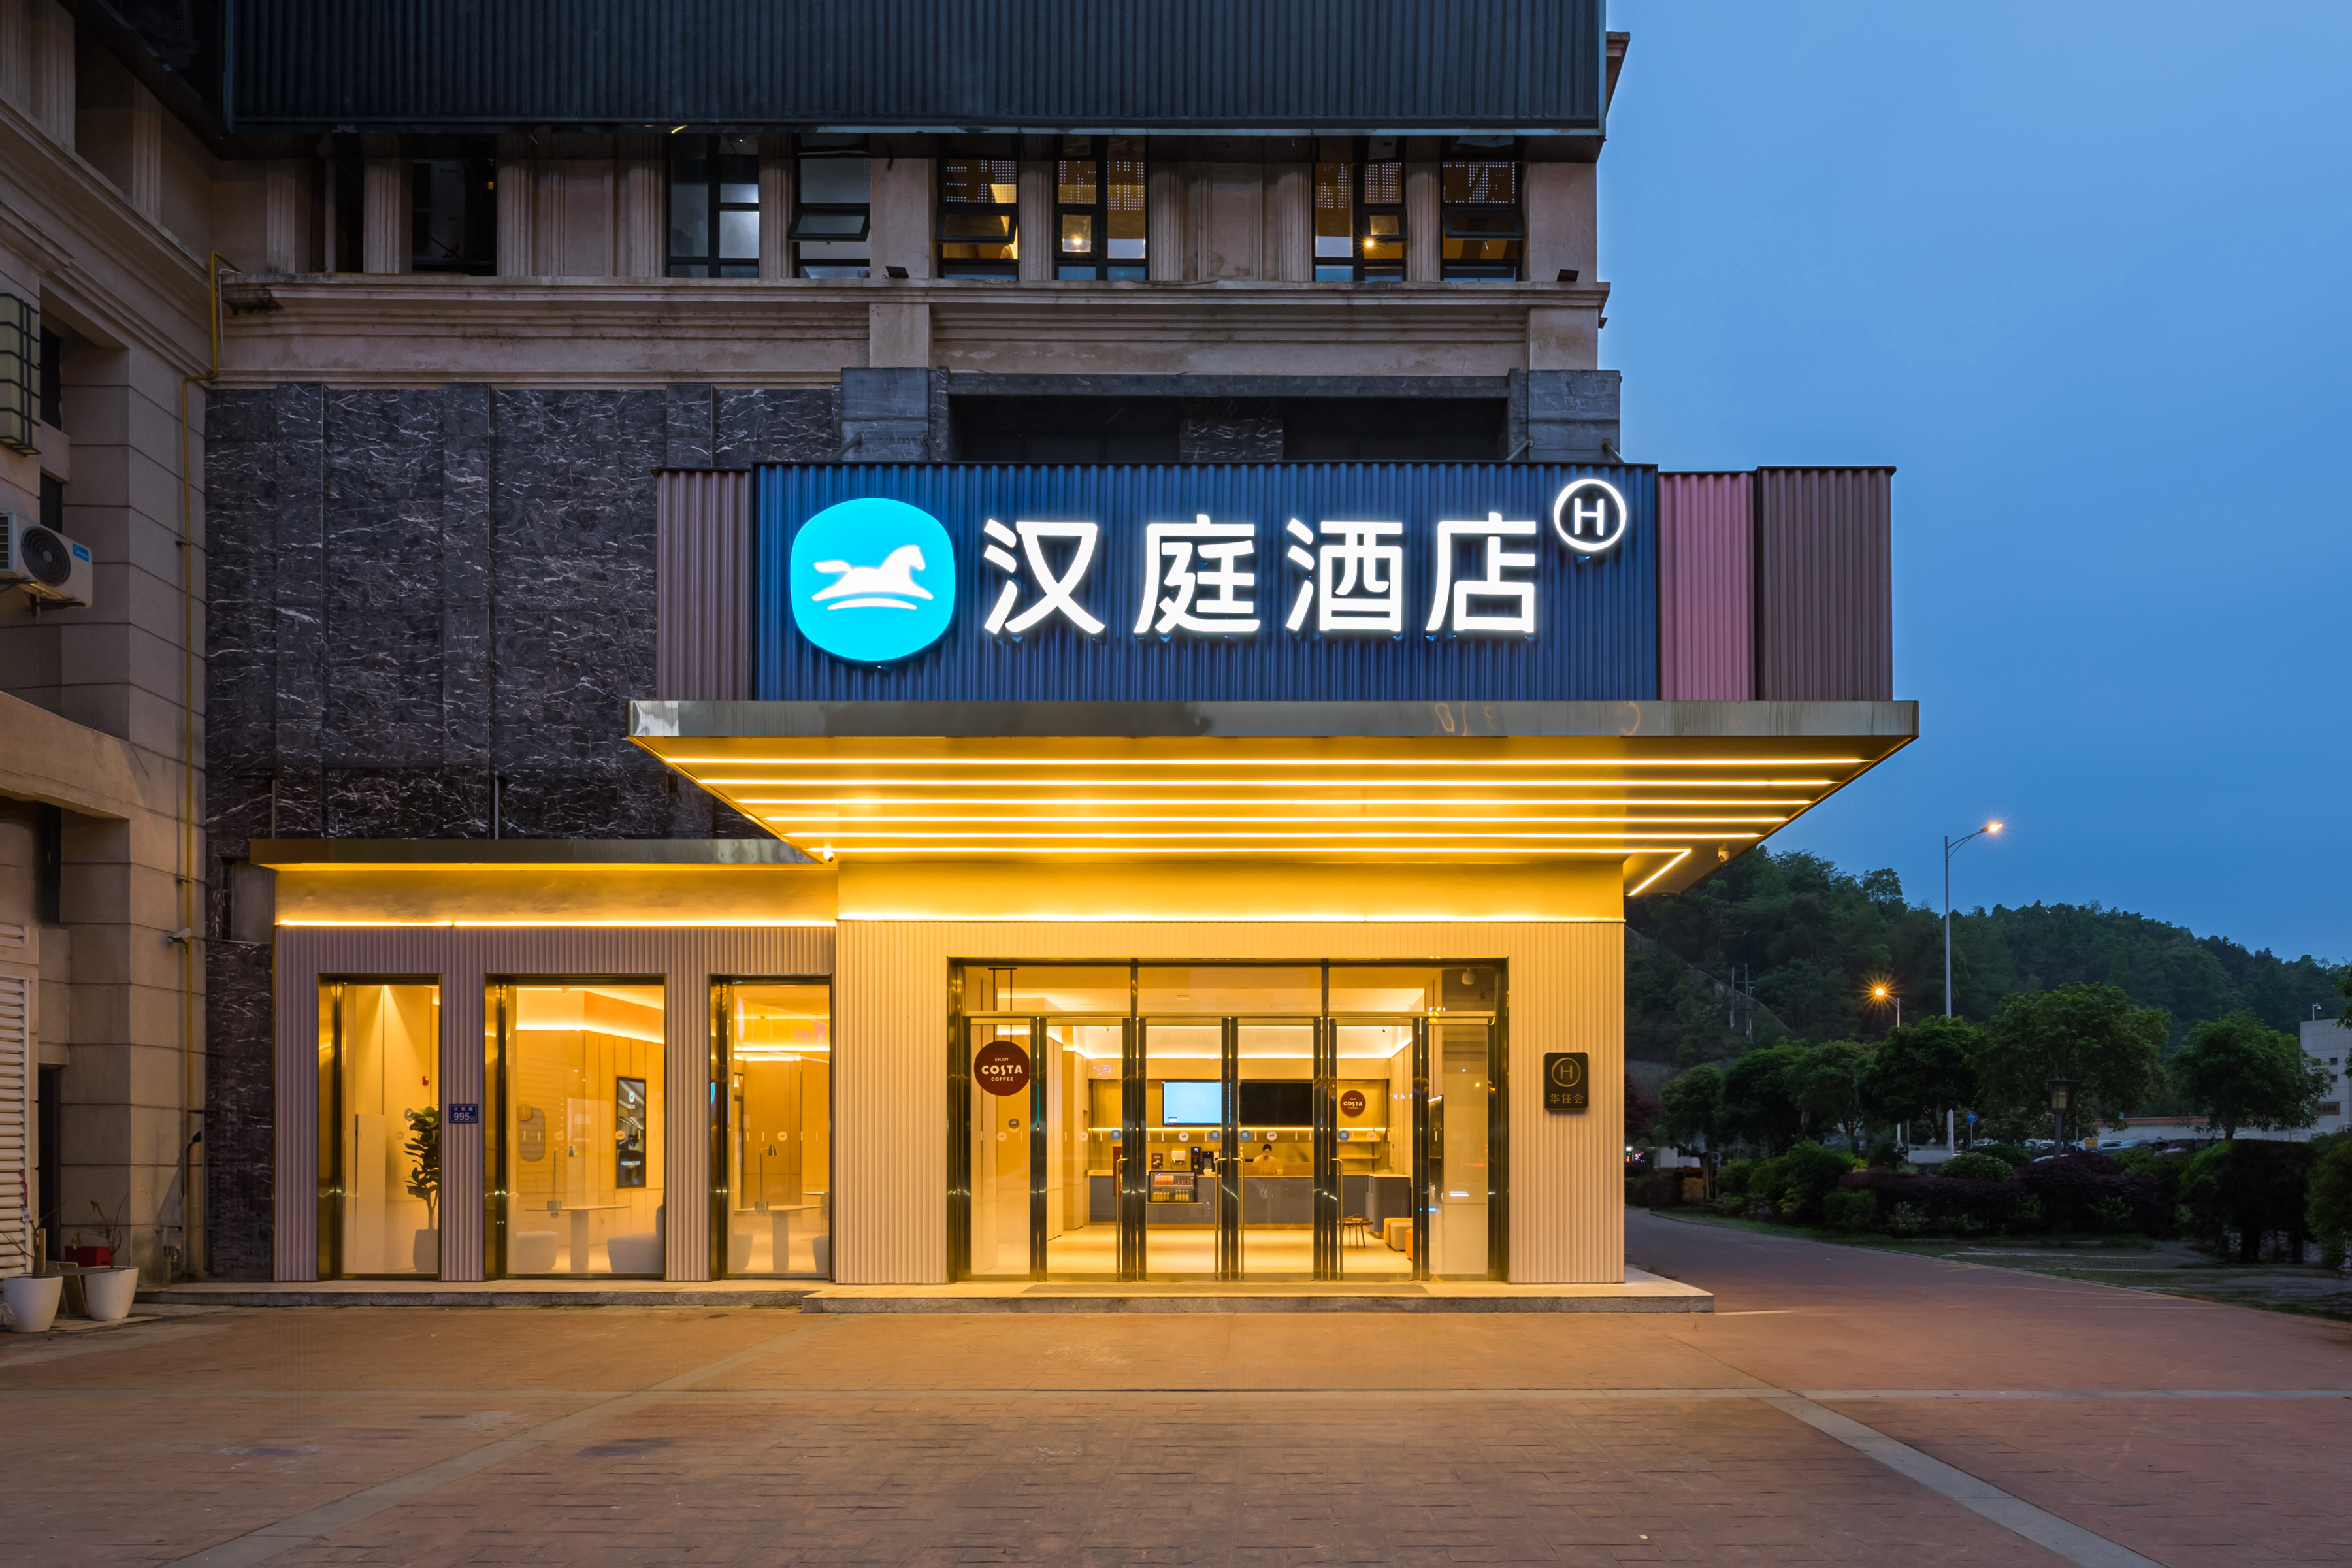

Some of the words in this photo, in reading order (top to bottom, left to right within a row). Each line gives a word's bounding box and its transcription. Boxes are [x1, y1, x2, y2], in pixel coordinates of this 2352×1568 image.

[1573, 497, 1605, 536] H
[984, 512, 1536, 635] 汉庭酒店
[981, 1065, 1023, 1076] COSTA
[1560, 1064, 1573, 1080] H
[1550, 1093, 1584, 1104] 华住会
